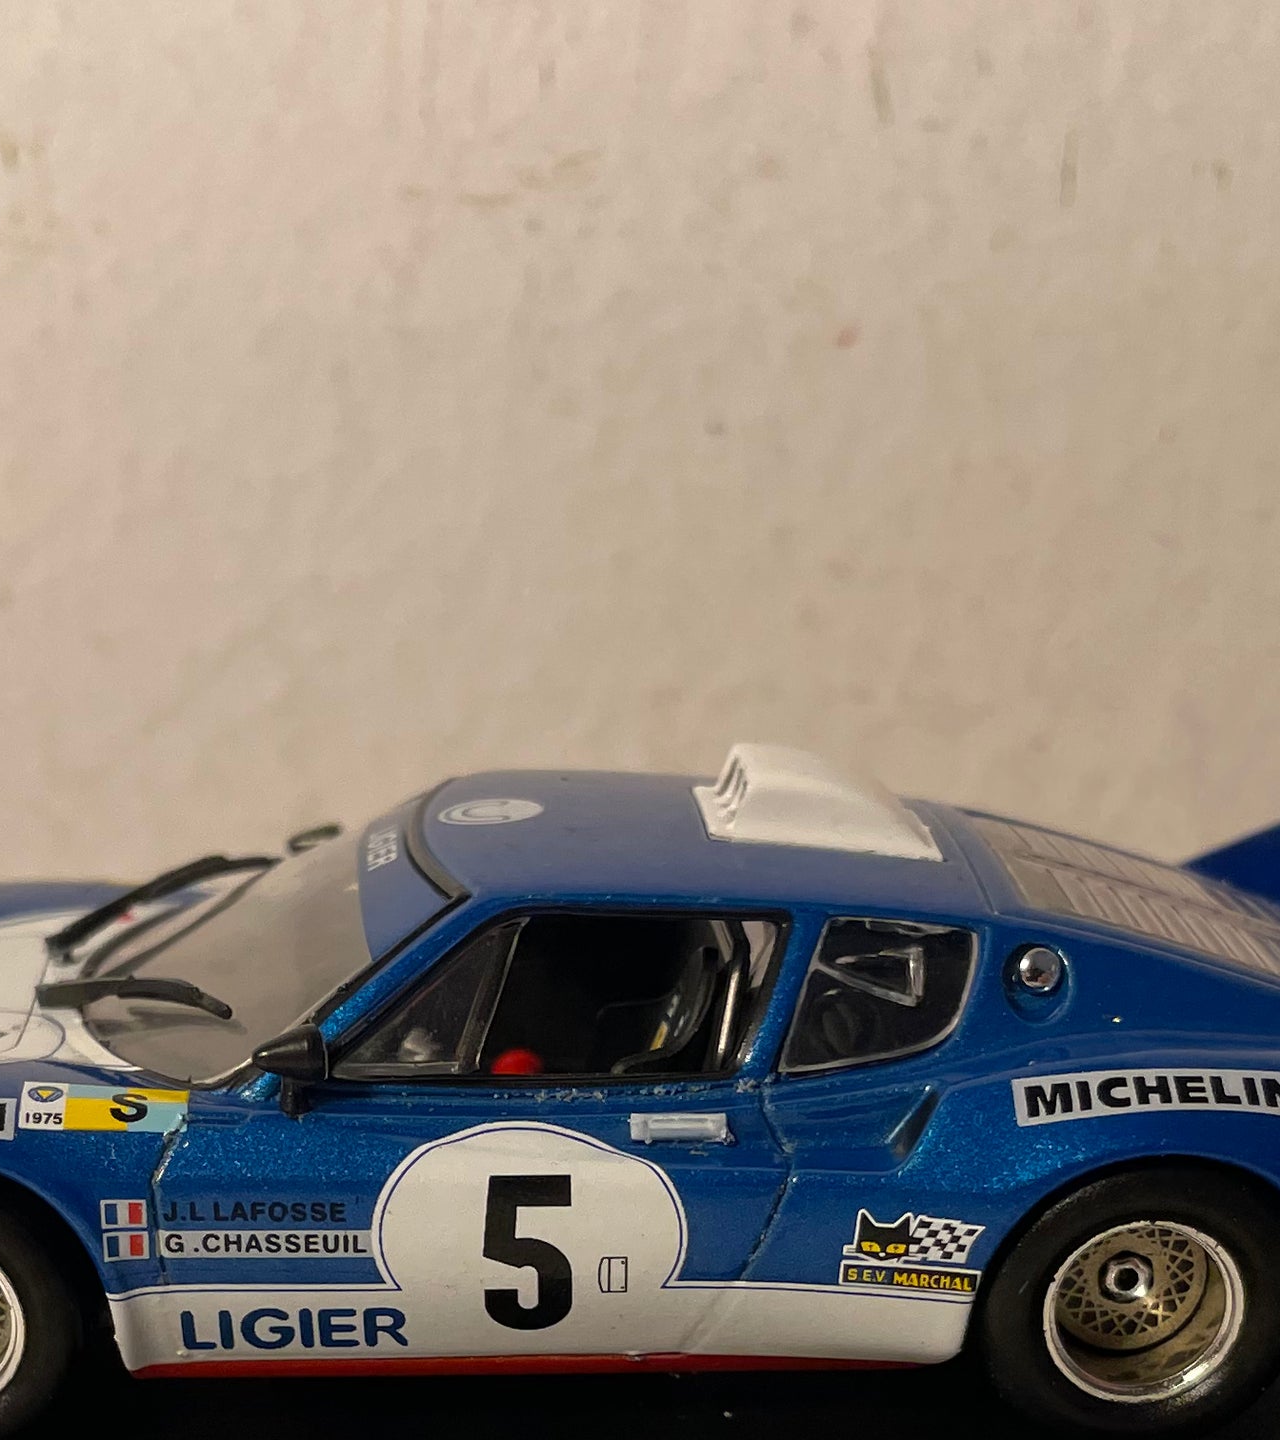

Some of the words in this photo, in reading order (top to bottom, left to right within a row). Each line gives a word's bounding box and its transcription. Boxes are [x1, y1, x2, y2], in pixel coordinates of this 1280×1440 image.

[26, 1112, 63, 1125] 1975
[110, 1093, 148, 1123] S
[213, 1202, 346, 1223] LAFOSSE
[483, 1174, 572, 1330] 5
[893, 1271, 972, 1291] MARCHAL
[179, 1307, 408, 1350] LIGIER
